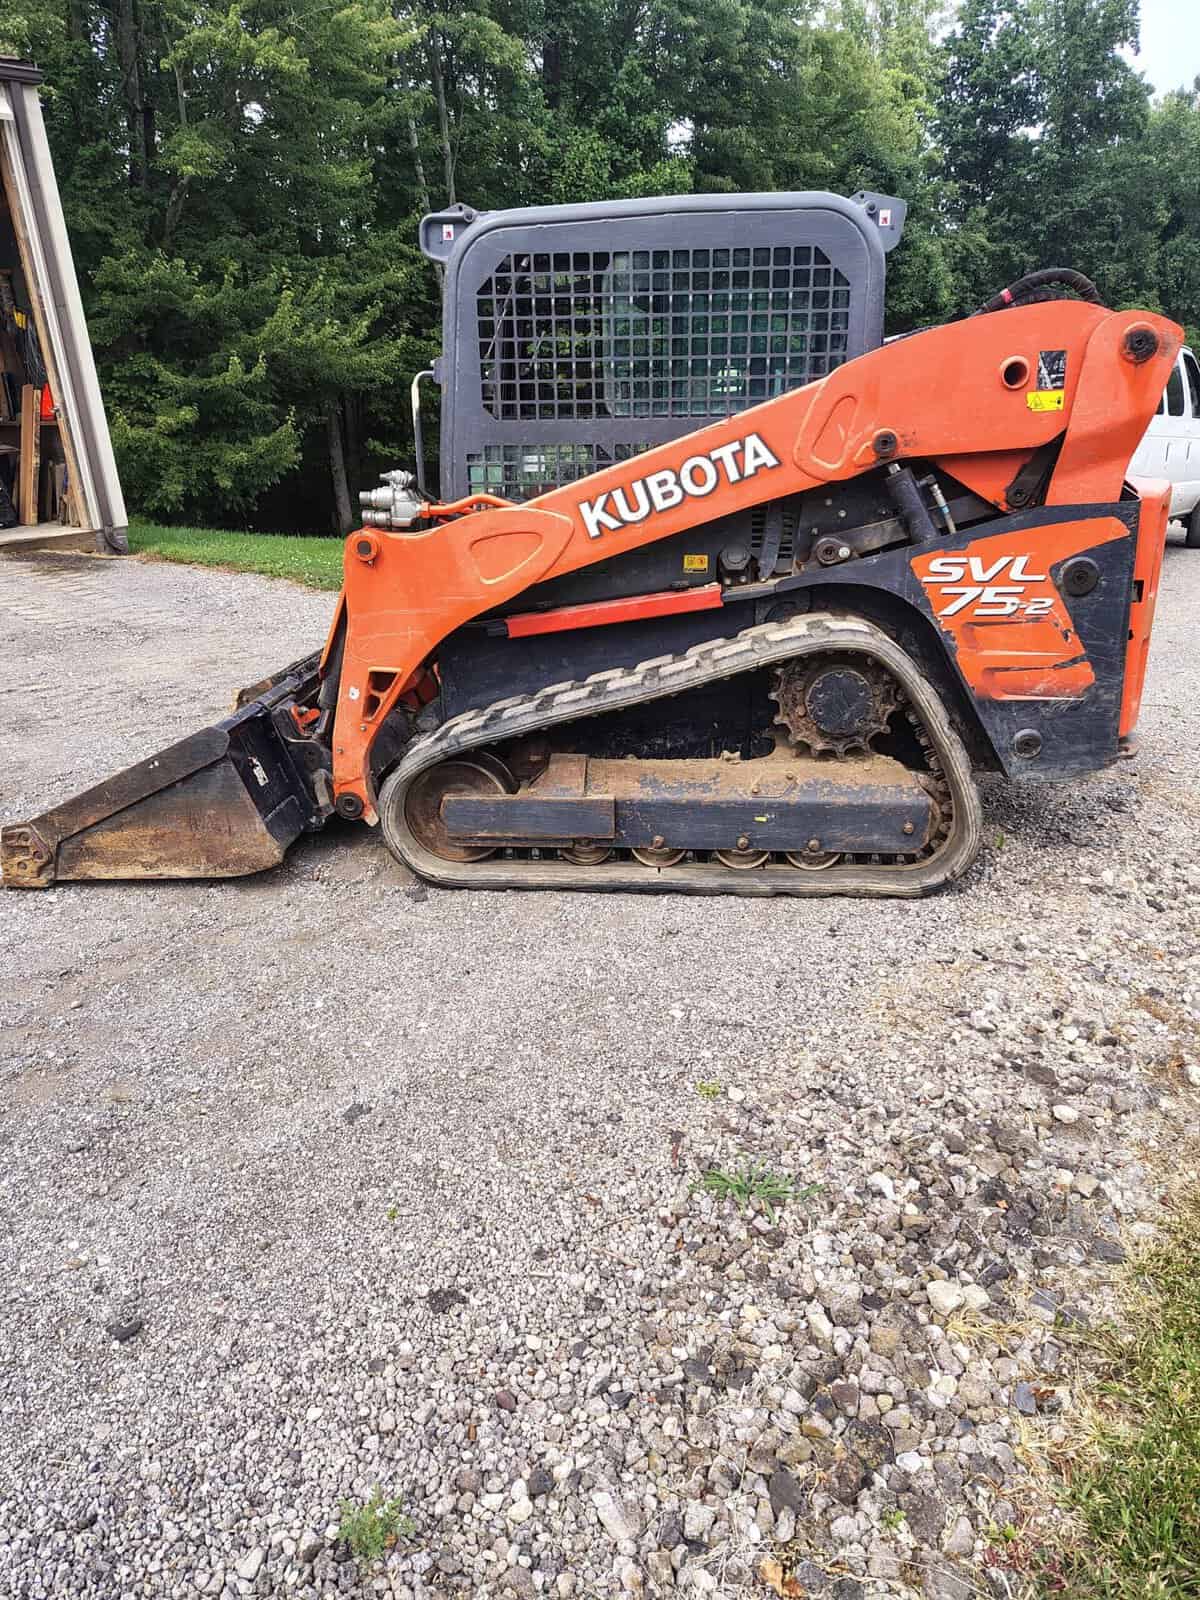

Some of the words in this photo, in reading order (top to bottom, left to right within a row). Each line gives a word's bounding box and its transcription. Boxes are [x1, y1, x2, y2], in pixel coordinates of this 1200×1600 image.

[578, 432, 781, 539] KUBOTA
[922, 556, 1046, 582] SVL
[937, 586, 1055, 616] 75-2
